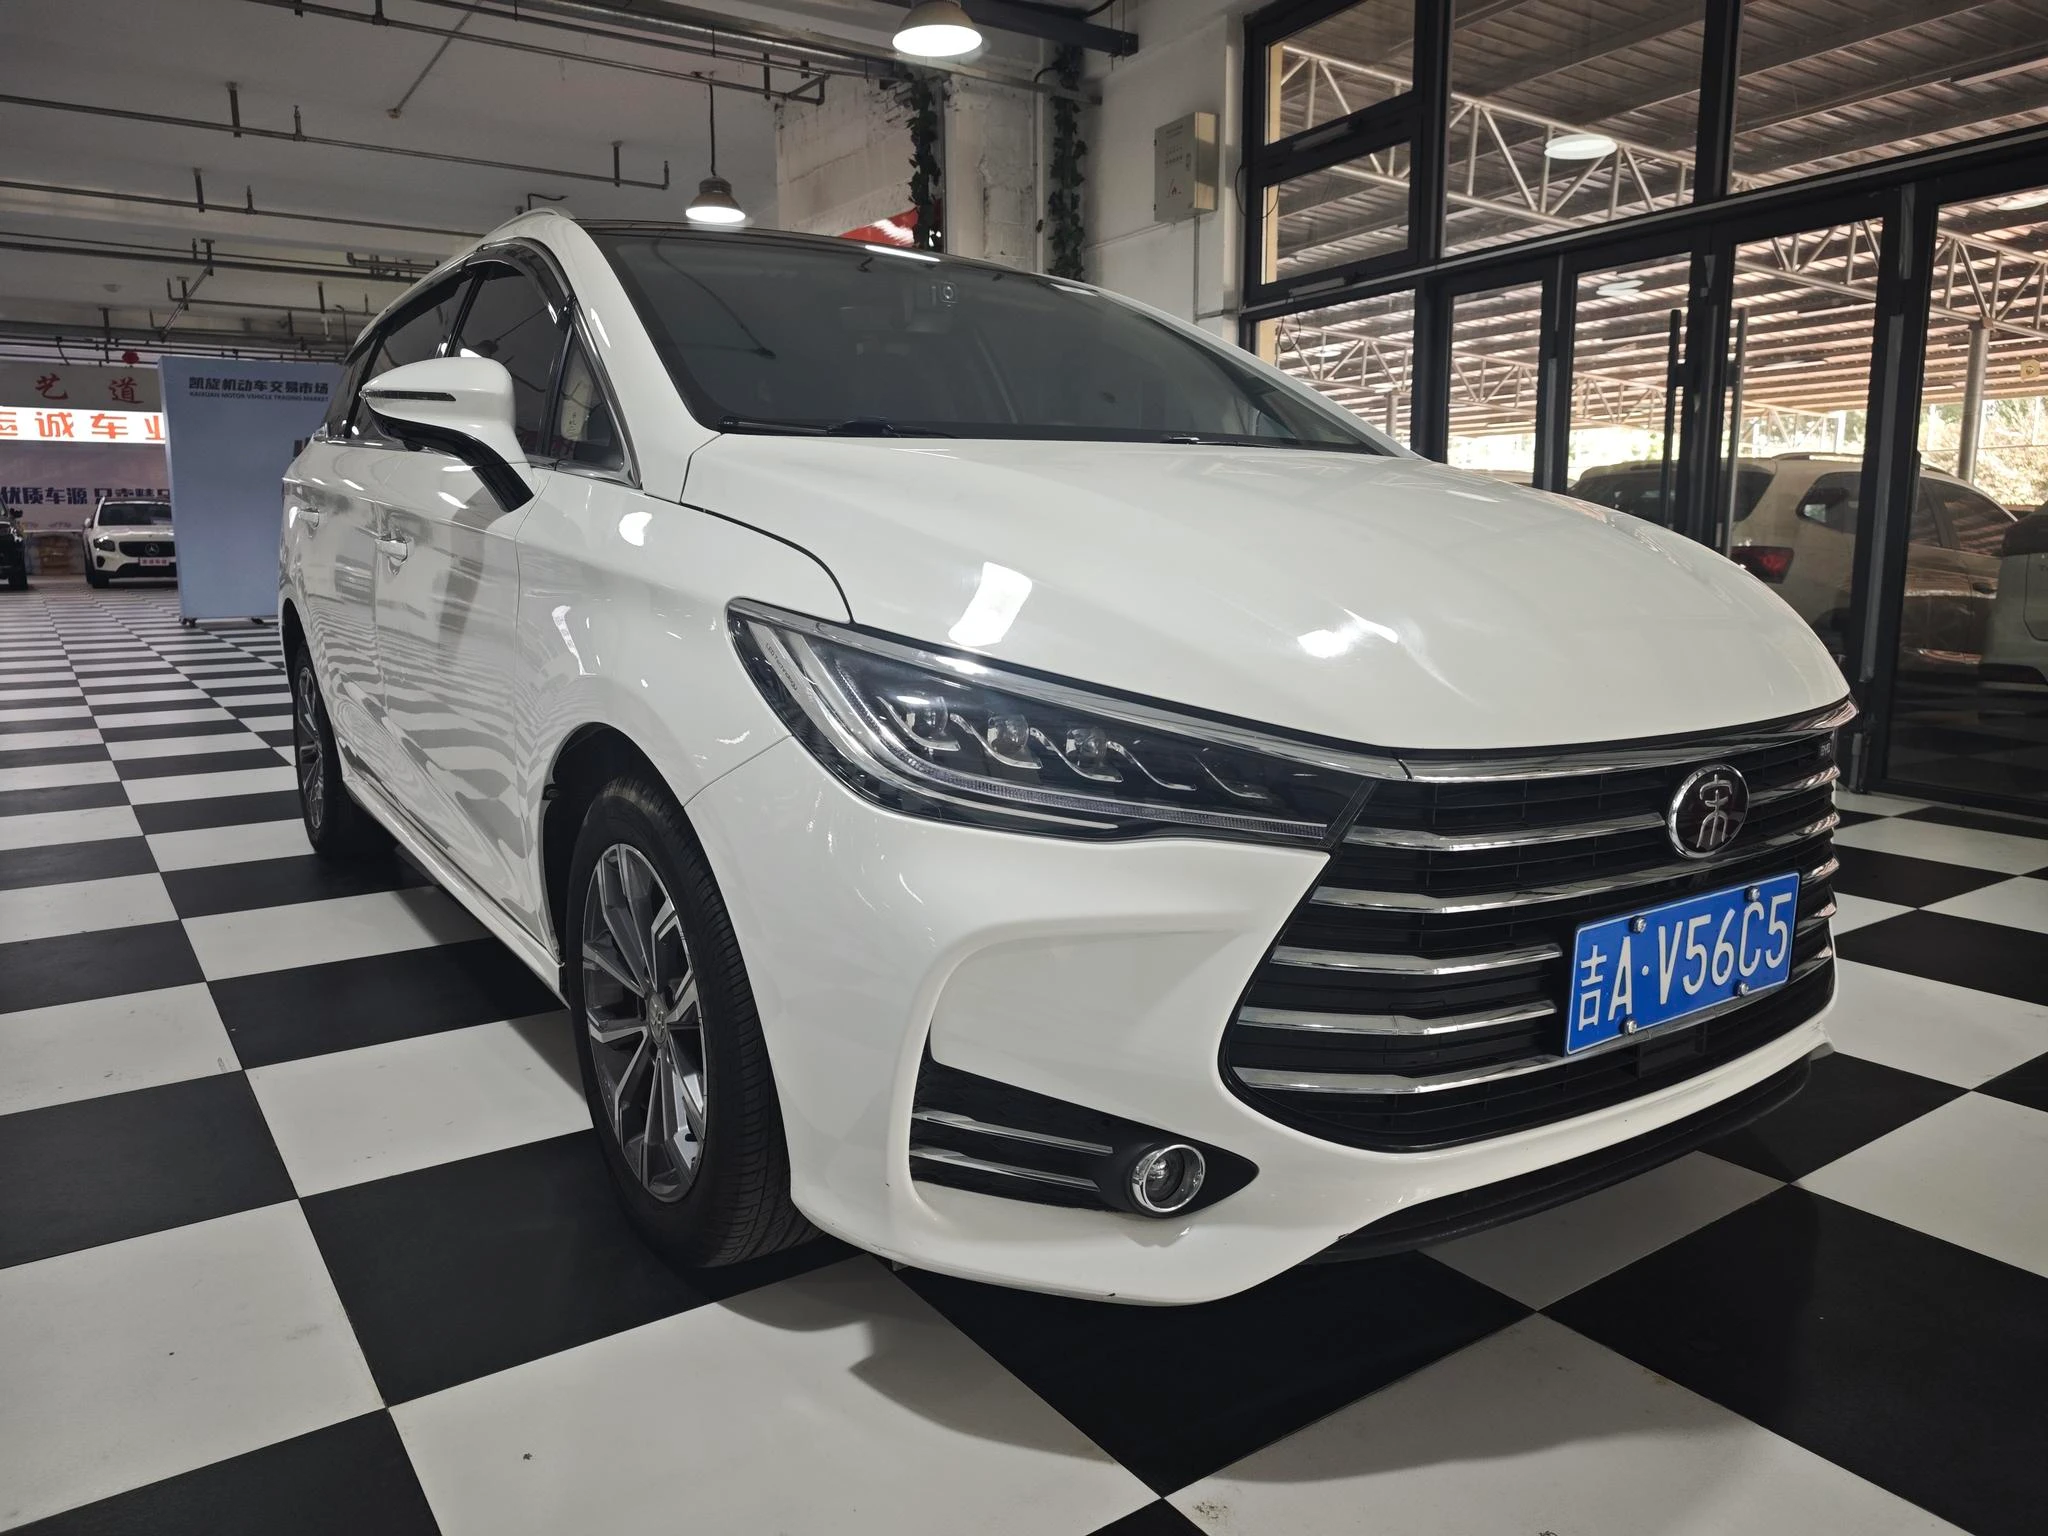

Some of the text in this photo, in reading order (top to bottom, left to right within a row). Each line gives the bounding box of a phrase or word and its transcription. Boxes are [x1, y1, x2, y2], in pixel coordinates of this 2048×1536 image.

[189, 377, 329, 395] 凯旋机动车交易市场
[1, 486, 88, 505] 优质车源
